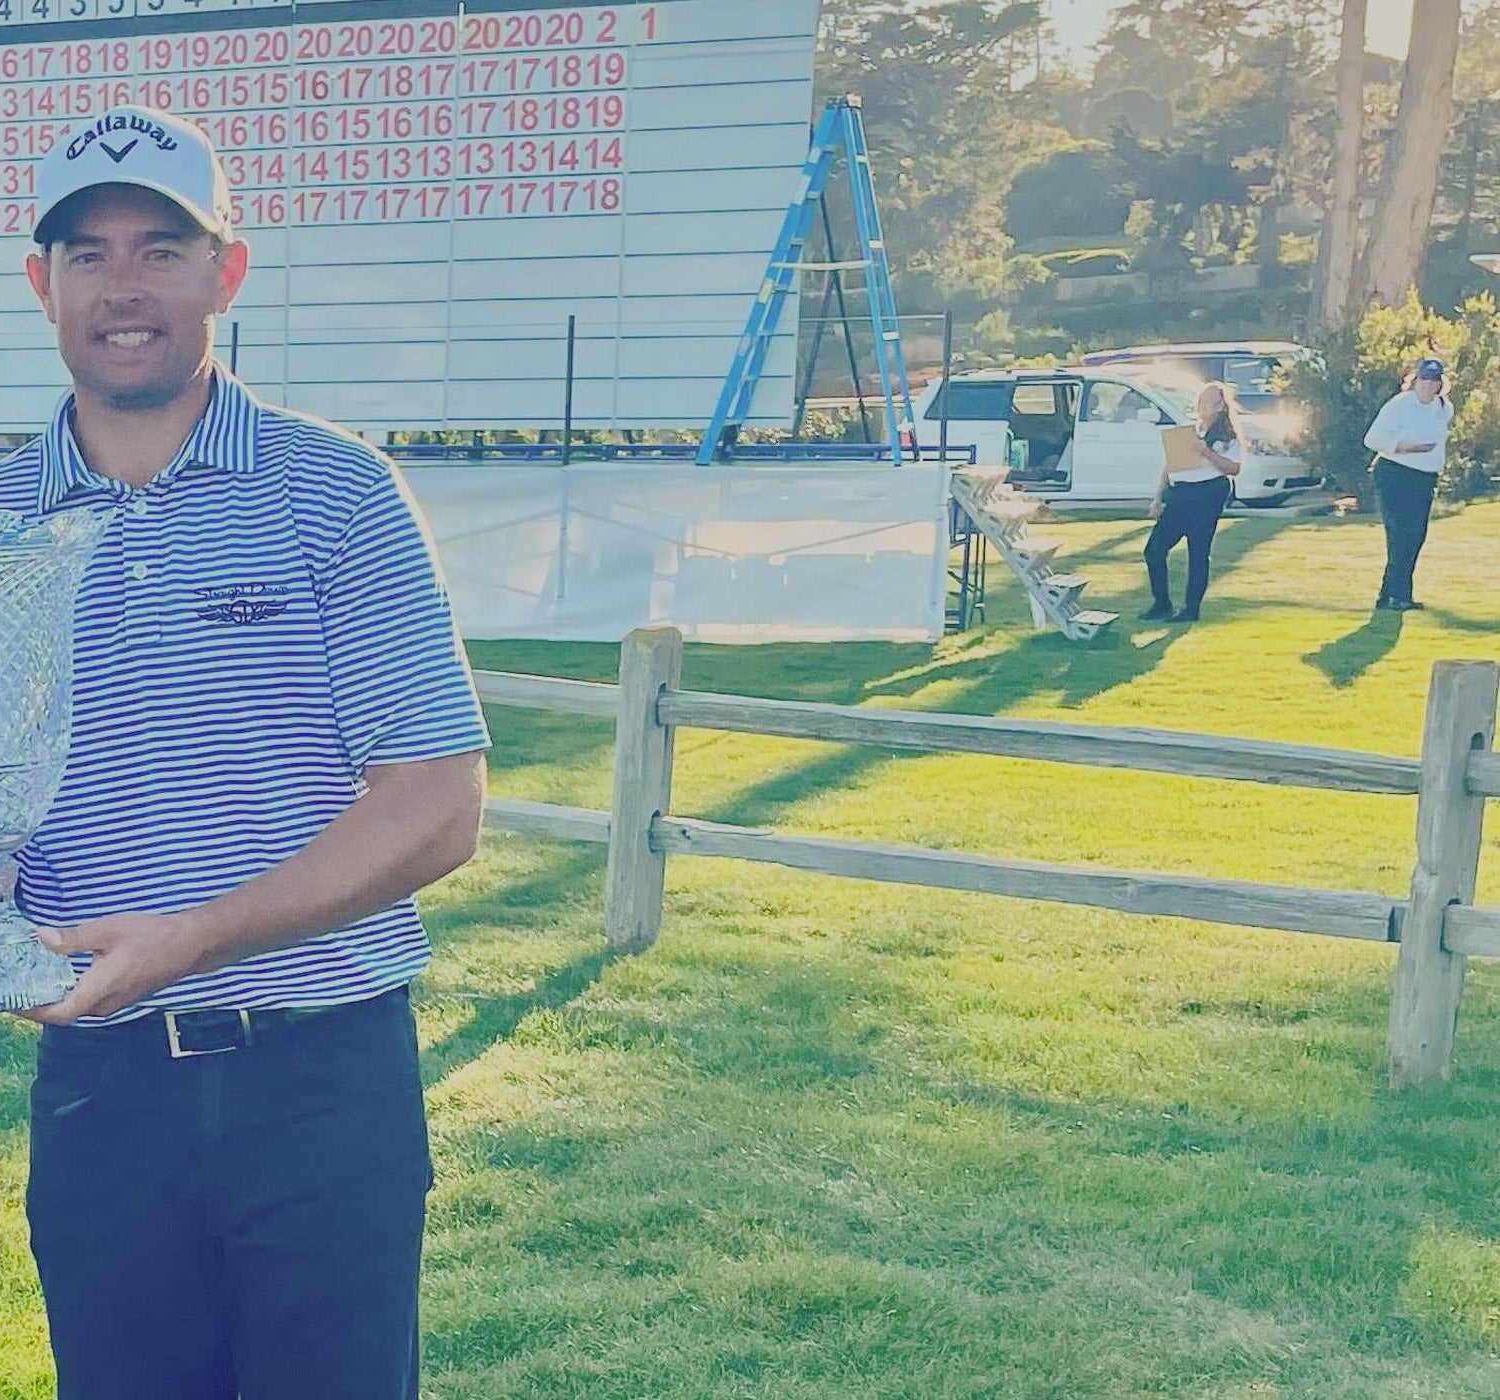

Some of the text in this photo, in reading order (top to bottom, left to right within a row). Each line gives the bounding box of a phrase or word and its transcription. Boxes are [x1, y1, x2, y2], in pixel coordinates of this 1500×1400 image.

[24, 46, 55, 73] 17
[60, 43, 90, 73] 18
[97, 42, 130, 72] 18
[137, 37, 173, 70] 19
[176, 34, 211, 67] 19
[214, 34, 249, 65] 20
[253, 30, 289, 63] 20
[297, 27, 333, 59] 20
[338, 24, 374, 57] 20
[379, 23, 416, 55] 20
[420, 19, 456, 54] 20
[465, 16, 502, 52] 20
[504, 14, 542, 48] 20
[544, 11, 584, 45] 20
[597, 9, 617, 42] 2
[22, 86, 55, 116] 14
[60, 83, 92, 114] 15
[138, 79, 173, 112] 16
[178, 76, 211, 108] 16
[216, 74, 250, 106] 15
[254, 71, 288, 104] 15
[293, 69, 329, 101] 16
[339, 66, 371, 99] 17
[379, 65, 413, 96] 18
[418, 63, 454, 95] 17
[463, 59, 499, 89] 17
[505, 56, 540, 88] 17
[546, 53, 581, 88] 18
[588, 52, 625, 86] 19
[23, 123, 56, 153] 15
[215, 115, 249, 147] 16
[252, 113, 286, 144] 16
[293, 110, 329, 141] 16
[335, 107, 370, 140] 15
[377, 105, 412, 139] 16
[417, 104, 454, 135] 16
[460, 100, 495, 132] 17
[505, 98, 539, 131] 18
[546, 97, 580, 128] 18
[586, 94, 623, 128] 19
[67, 115, 178, 160] Callaway
[251, 154, 284, 182] 14
[294, 152, 327, 180] 14
[335, 148, 371, 180] 15
[376, 147, 411, 178] 13
[415, 144, 451, 176] 13
[457, 141, 494, 174] 13
[502, 139, 537, 173] 13
[542, 141, 578, 172] 14
[584, 138, 622, 167] 14
[250, 192, 286, 224] 16
[291, 189, 328, 221] 17
[334, 189, 368, 218] 17
[377, 187, 409, 217] 17
[415, 186, 449, 216] 17
[458, 182, 493, 215] 17
[499, 181, 538, 210] 17
[542, 179, 578, 209] 17
[584, 178, 619, 210] 18
